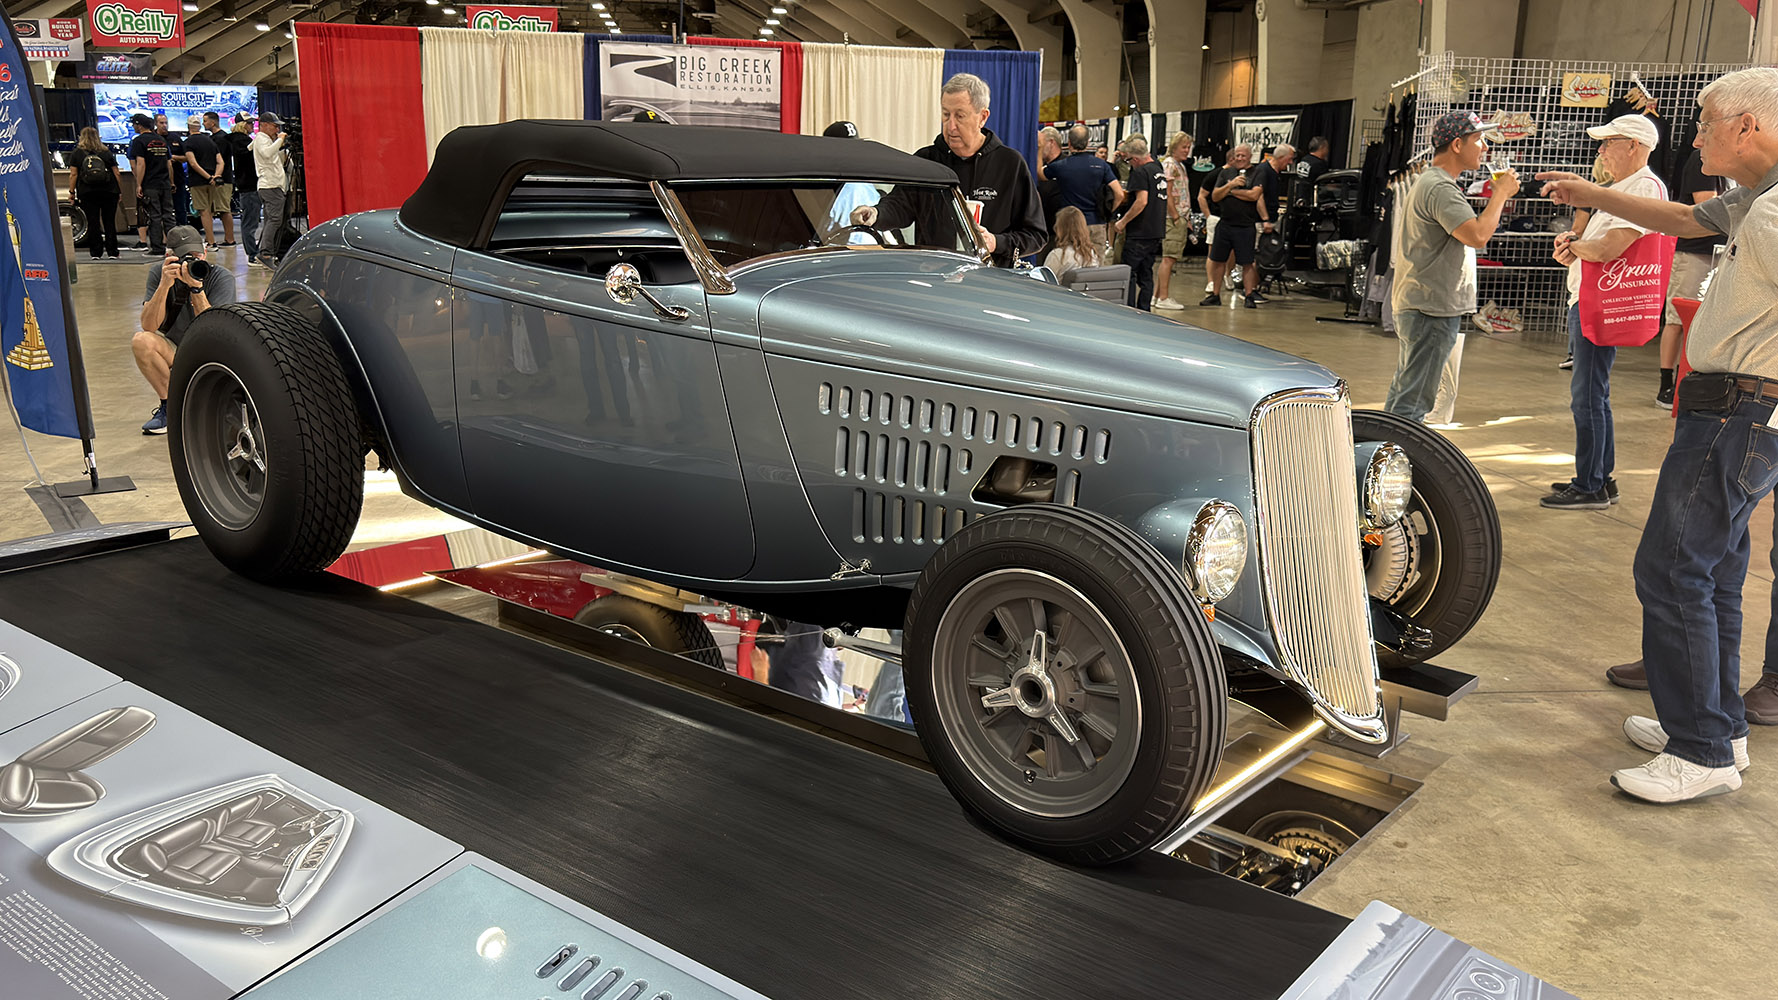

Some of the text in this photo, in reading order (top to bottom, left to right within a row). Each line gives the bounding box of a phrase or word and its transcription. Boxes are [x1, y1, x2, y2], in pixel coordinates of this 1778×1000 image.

[98, 7, 172, 35] O'Reilly
[97, 60, 131, 71] GLITZ
[680, 55, 771, 74] BIG CREEK
[680, 71, 771, 85] RESTORATION
[161, 92, 205, 101] SOUTH CITY
[845, 123, 857, 137] B
[25, 269, 49, 279] ARP
[1602, 296, 1632, 304] COLLECTOR
